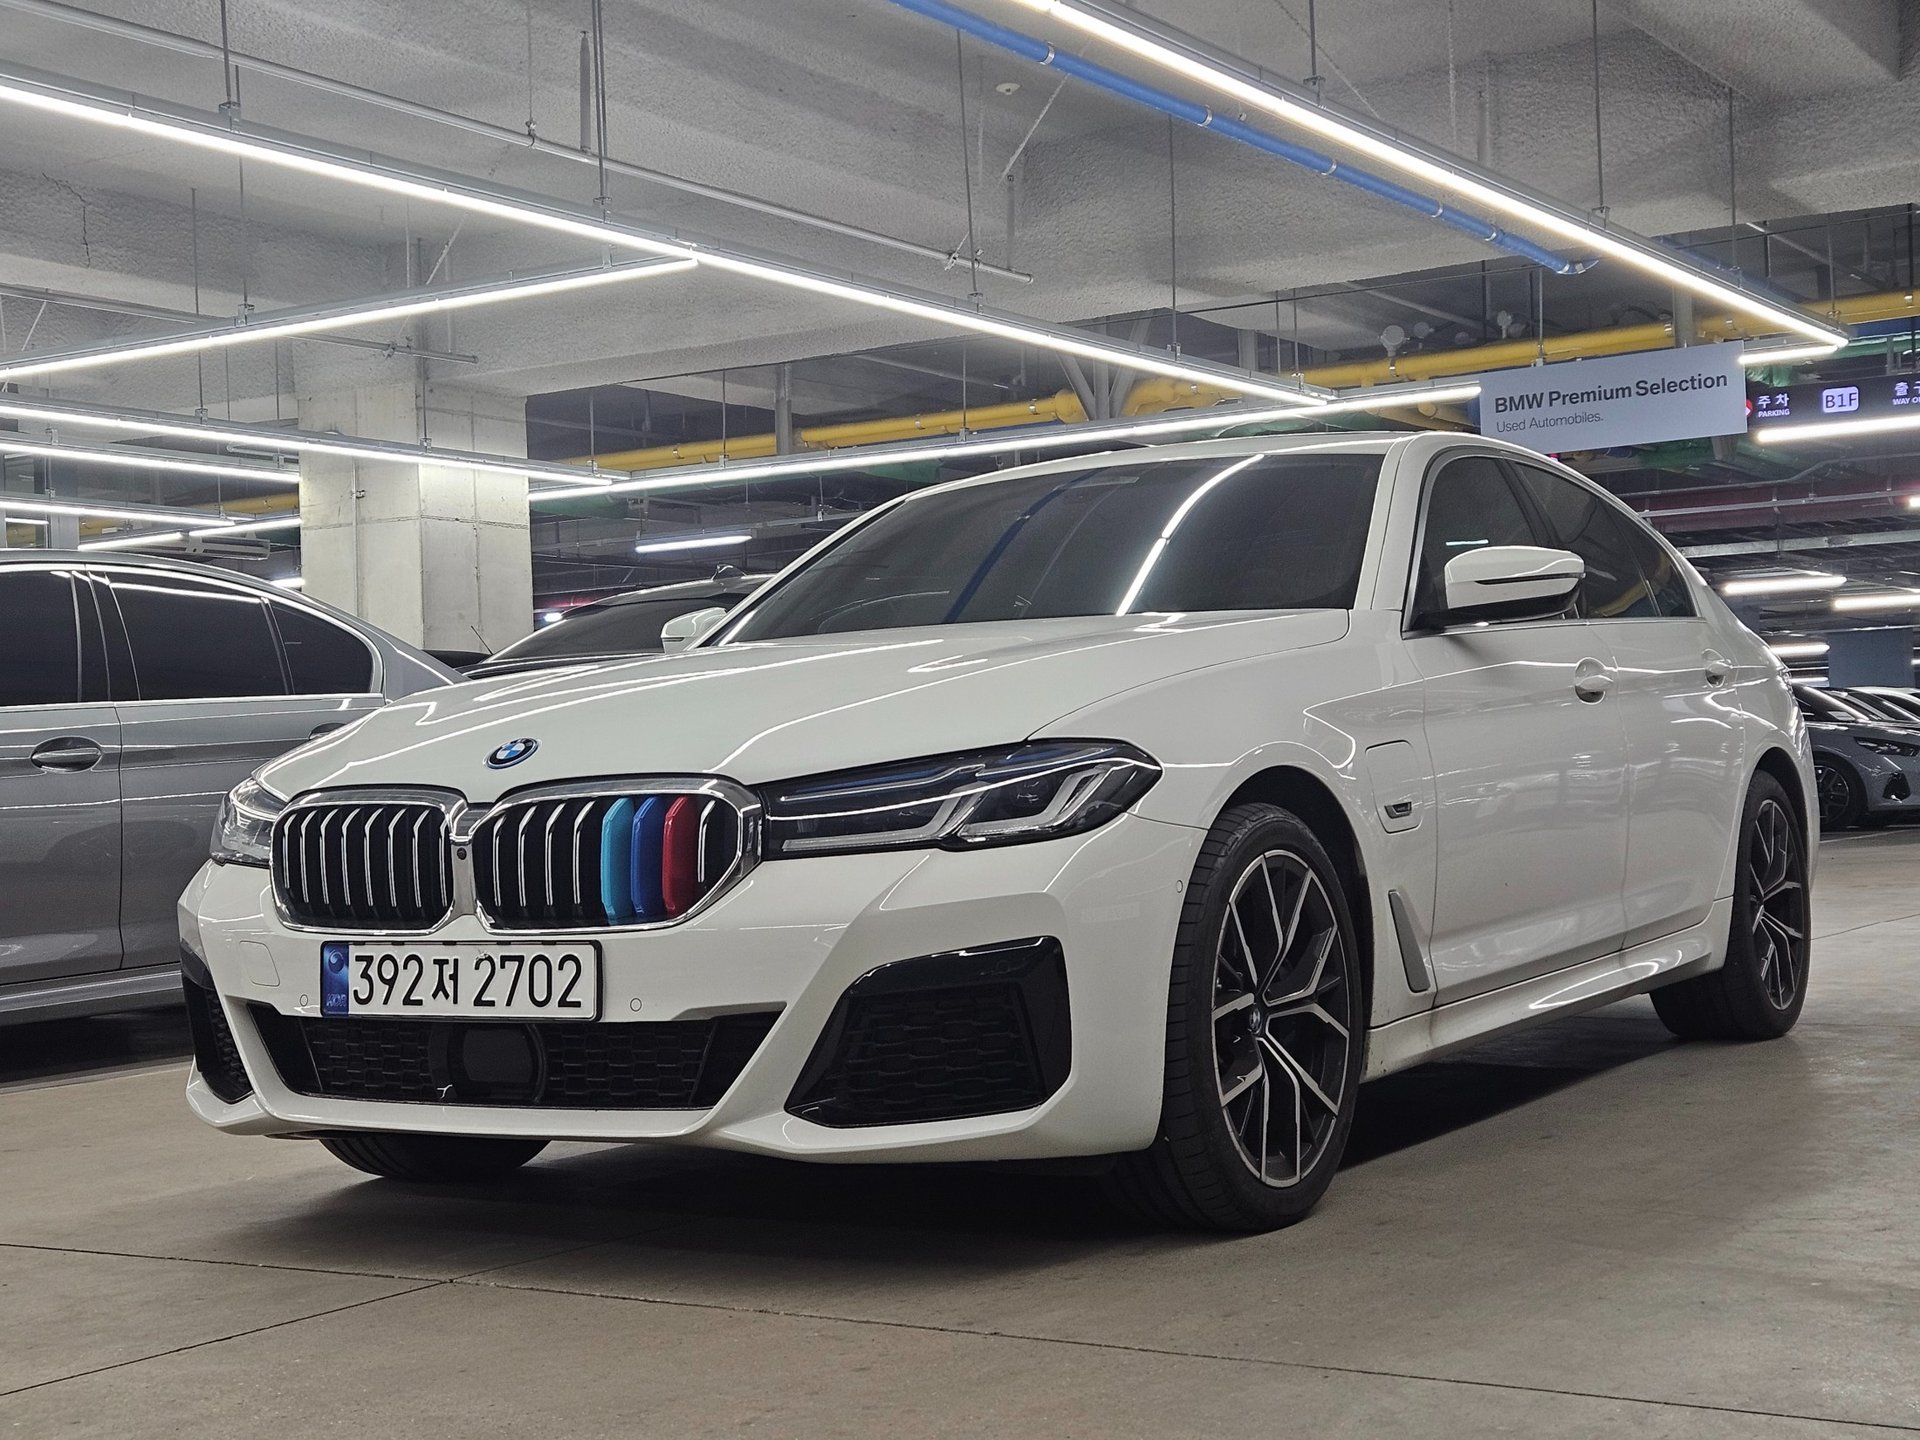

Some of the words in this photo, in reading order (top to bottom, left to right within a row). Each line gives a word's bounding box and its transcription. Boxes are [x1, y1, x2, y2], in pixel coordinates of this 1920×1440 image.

[1495, 392, 1544, 413] BMW
[1549, 385, 1632, 408] Premium
[1635, 373, 1728, 397] Selection
[1825, 392, 1857, 408] B1F
[1892, 397, 1910, 405] WAY
[1496, 415, 1526, 433] Used
[1529, 411, 1604, 430] Automobiles.
[1758, 408, 1790, 417] PARKING
[472, 953, 583, 1008] 2702
